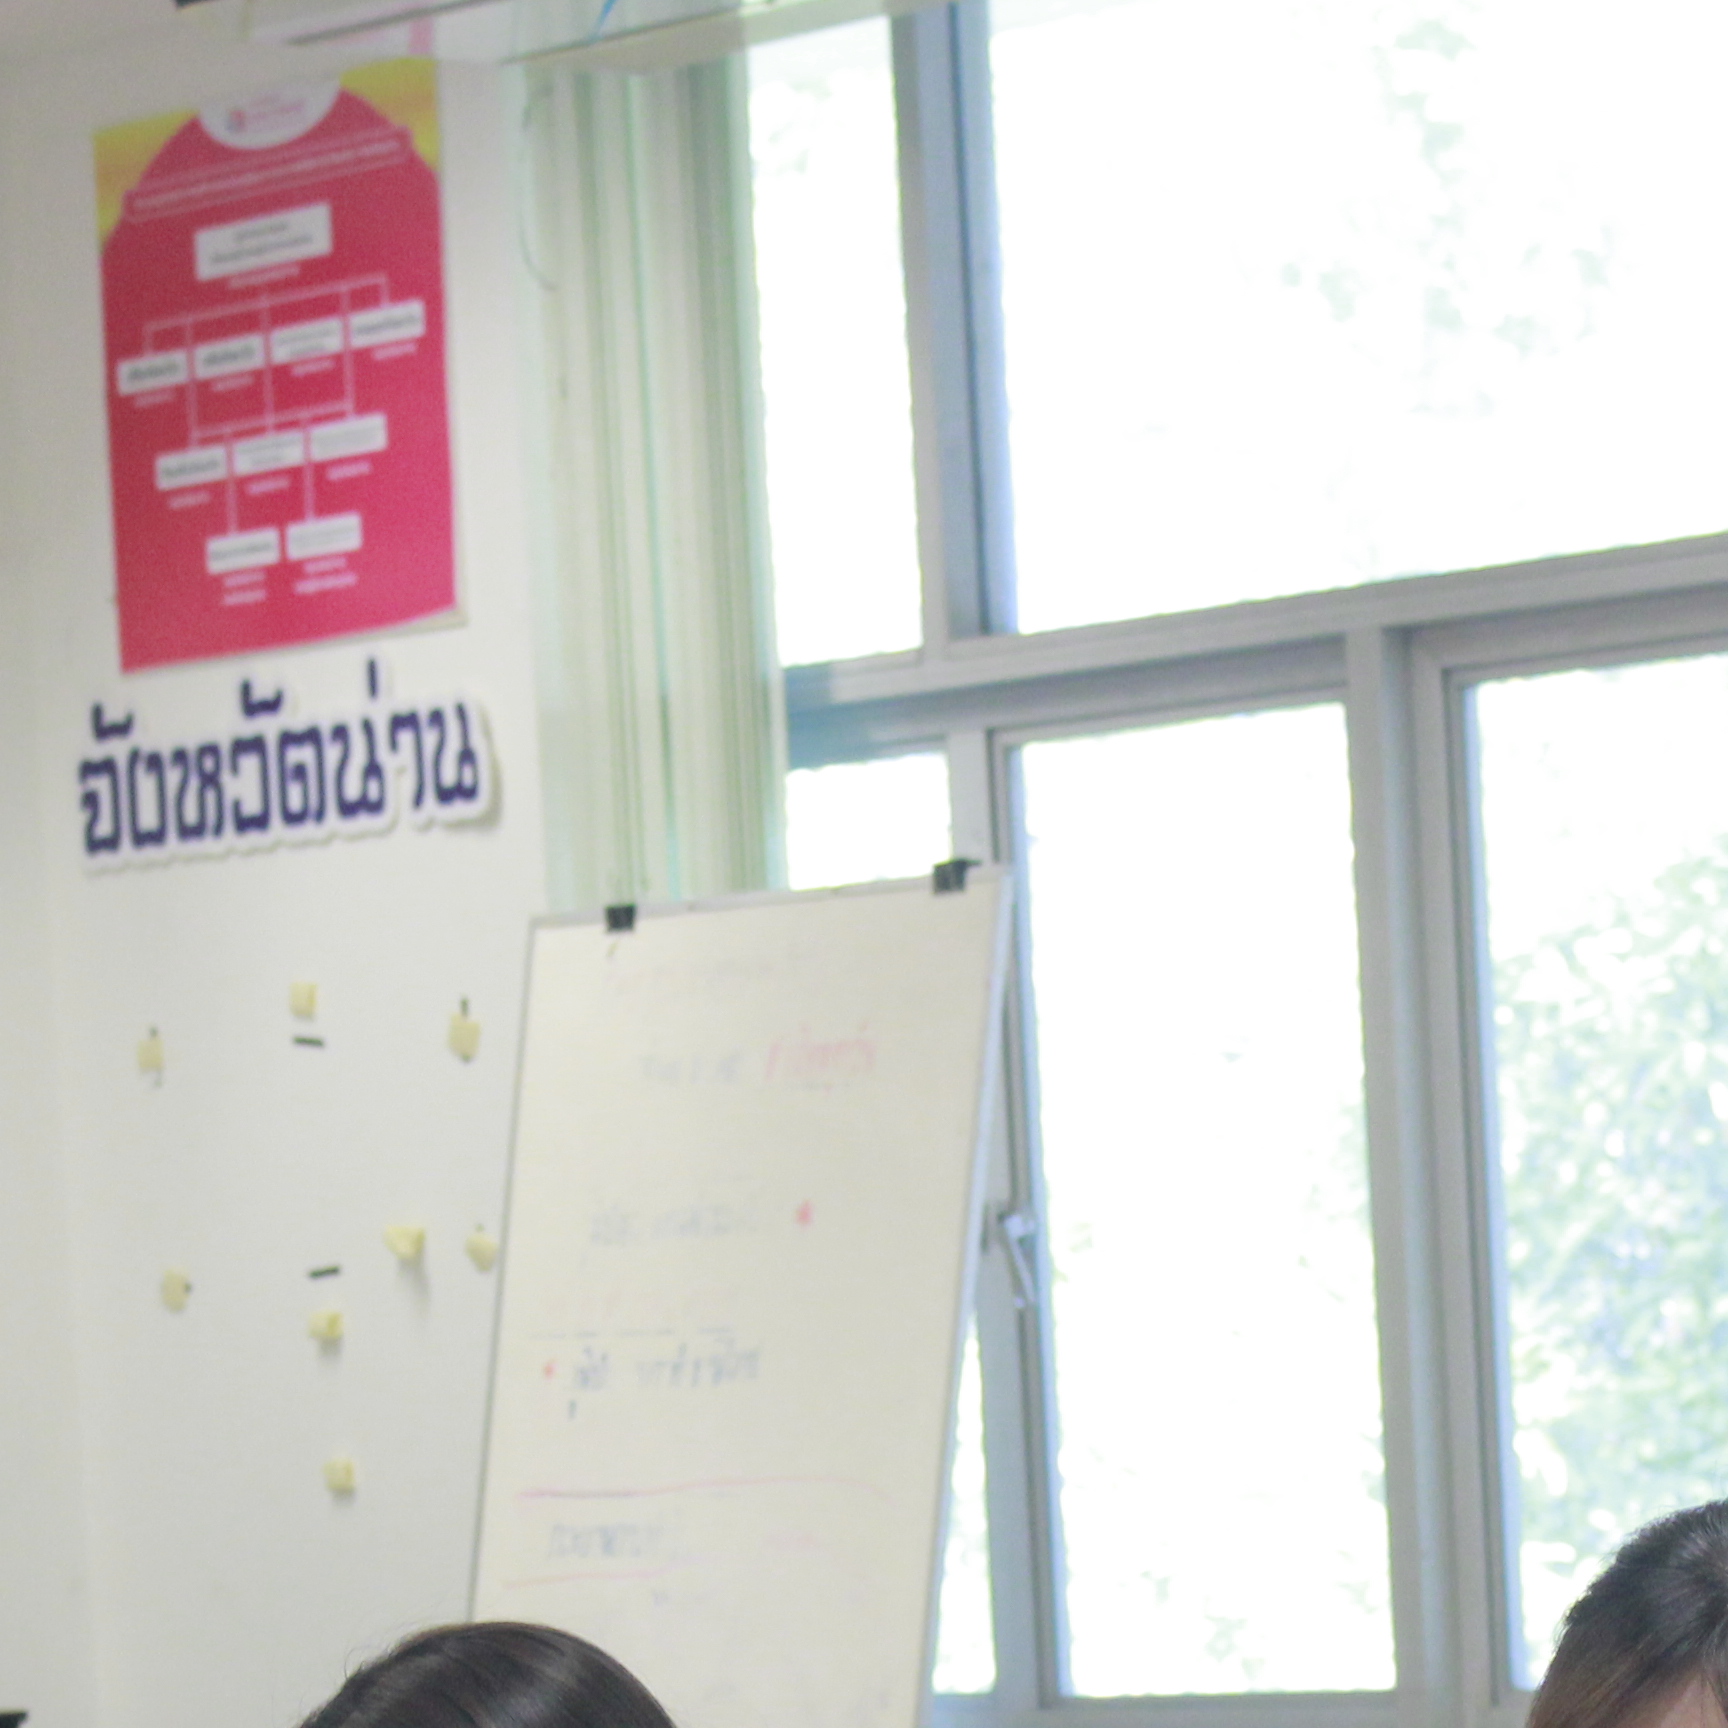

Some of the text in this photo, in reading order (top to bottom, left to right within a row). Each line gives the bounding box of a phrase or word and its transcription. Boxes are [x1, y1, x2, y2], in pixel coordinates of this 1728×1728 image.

[78, 656, 480, 857] จังหวัดน่าน
